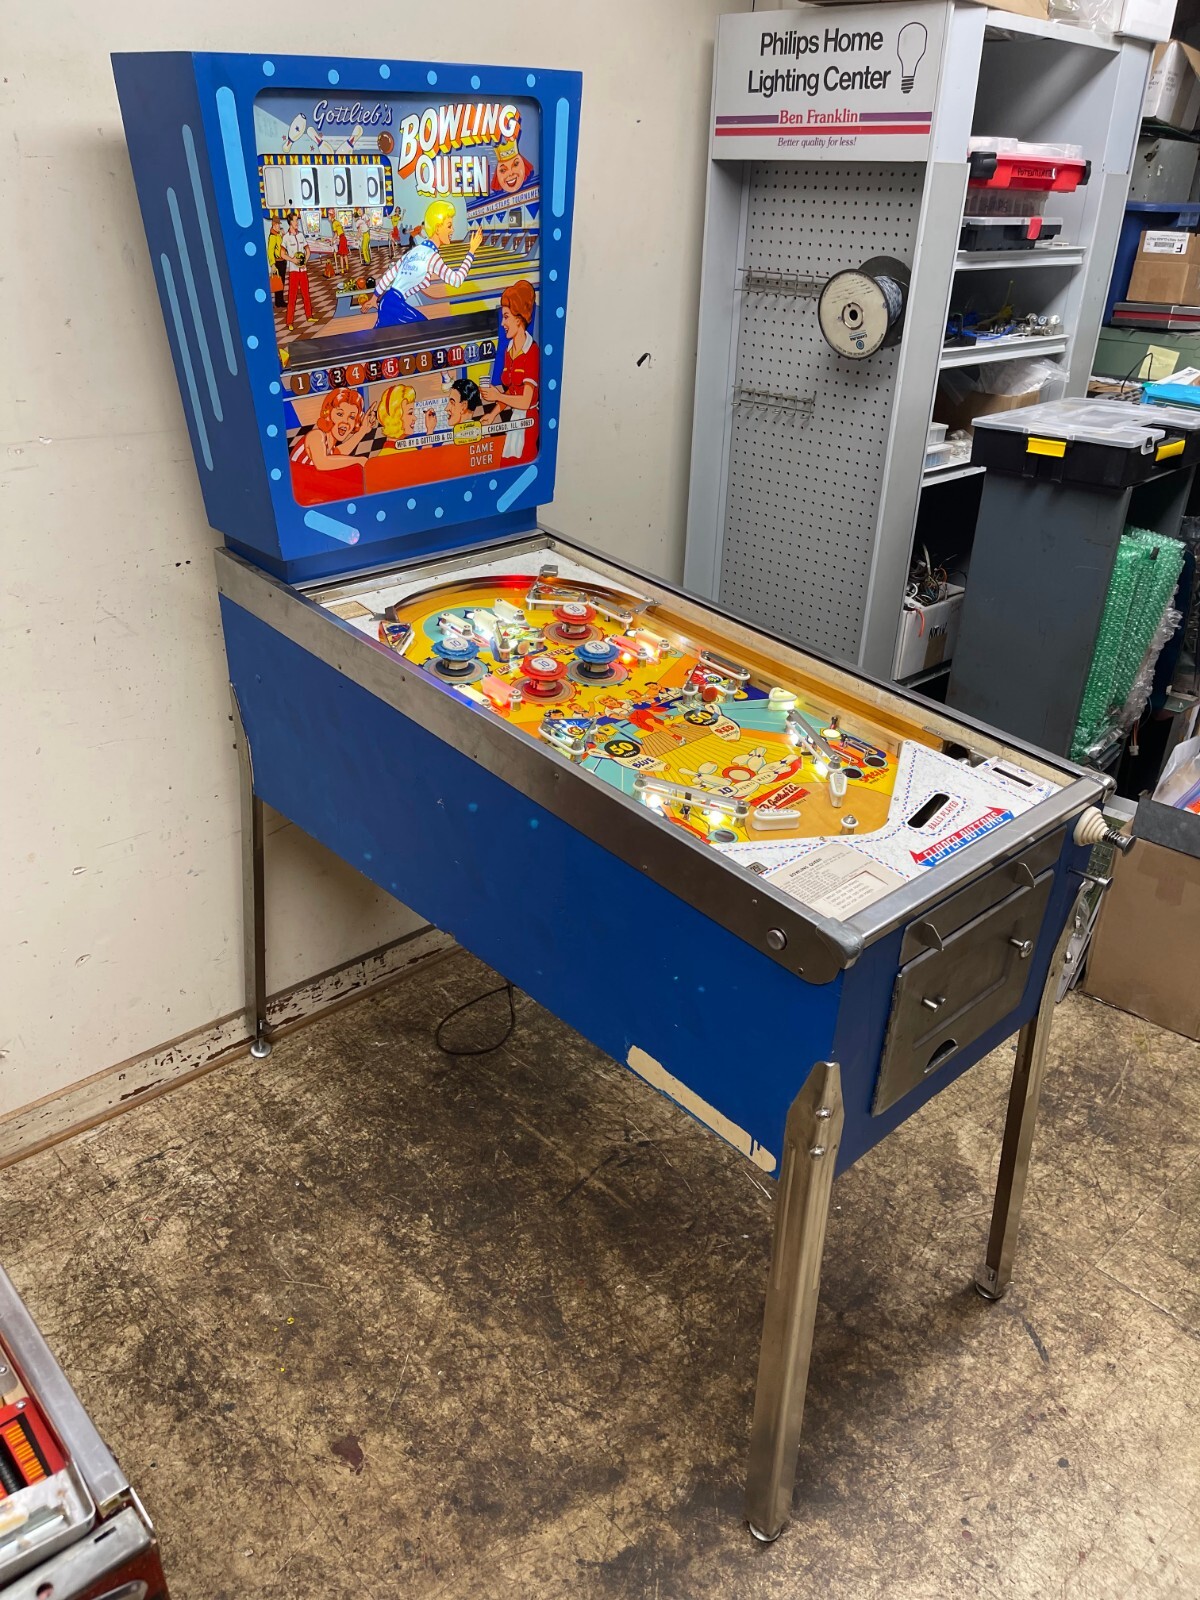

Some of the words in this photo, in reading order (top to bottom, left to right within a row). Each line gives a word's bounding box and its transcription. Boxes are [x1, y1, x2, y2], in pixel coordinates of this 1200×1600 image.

[760, 30, 820, 60] Philips
[823, 28, 883, 53] Home
[747, 68, 820, 98] Lighting
[823, 65, 891, 92] Center
[313, 100, 392, 129] Gottlieb's
[779, 110, 803, 125] Ben
[806, 108, 858, 125] Franklin
[399, 103, 519, 173] BOWLING
[777, 137, 799, 147] Better
[800, 137, 826, 149] quality
[827, 137, 838, 148] for
[839, 136, 857, 146] less!
[416, 156, 488, 197] QUEEN
[334, 175, 345, 197] 0
[367, 176, 378, 198] 0
[297, 376, 304, 390] 1
[315, 373, 324, 386] 2
[333, 370, 341, 383] 3
[351, 366, 360, 379] 4
[370, 363, 378, 376] 5
[387, 360, 395, 373] 6
[403, 358, 410, 370] 7
[420, 354, 428, 367] 8
[436, 351, 444, 364] 9
[452, 348, 462, 361] 10
[467, 345, 476, 358] 11
[482, 342, 492, 355] 12
[420, 434, 440, 445] GOTTLIEB
[469, 441, 494, 455] GAME
[470, 453, 493, 467] OVER
[689, 711, 711, 724] 50
[714, 725, 735, 734] RED
[609, 742, 634, 755] 50
[632, 757, 655, 768] BLUE
[859, 767, 889, 783] SPECIAL
[718, 786, 733, 795] 10
[928, 814, 944, 830] BALLS
[940, 800, 959, 818] PLAYED
[923, 835, 964, 862] FLIPPER
[959, 812, 1004, 841] BUTTONS
